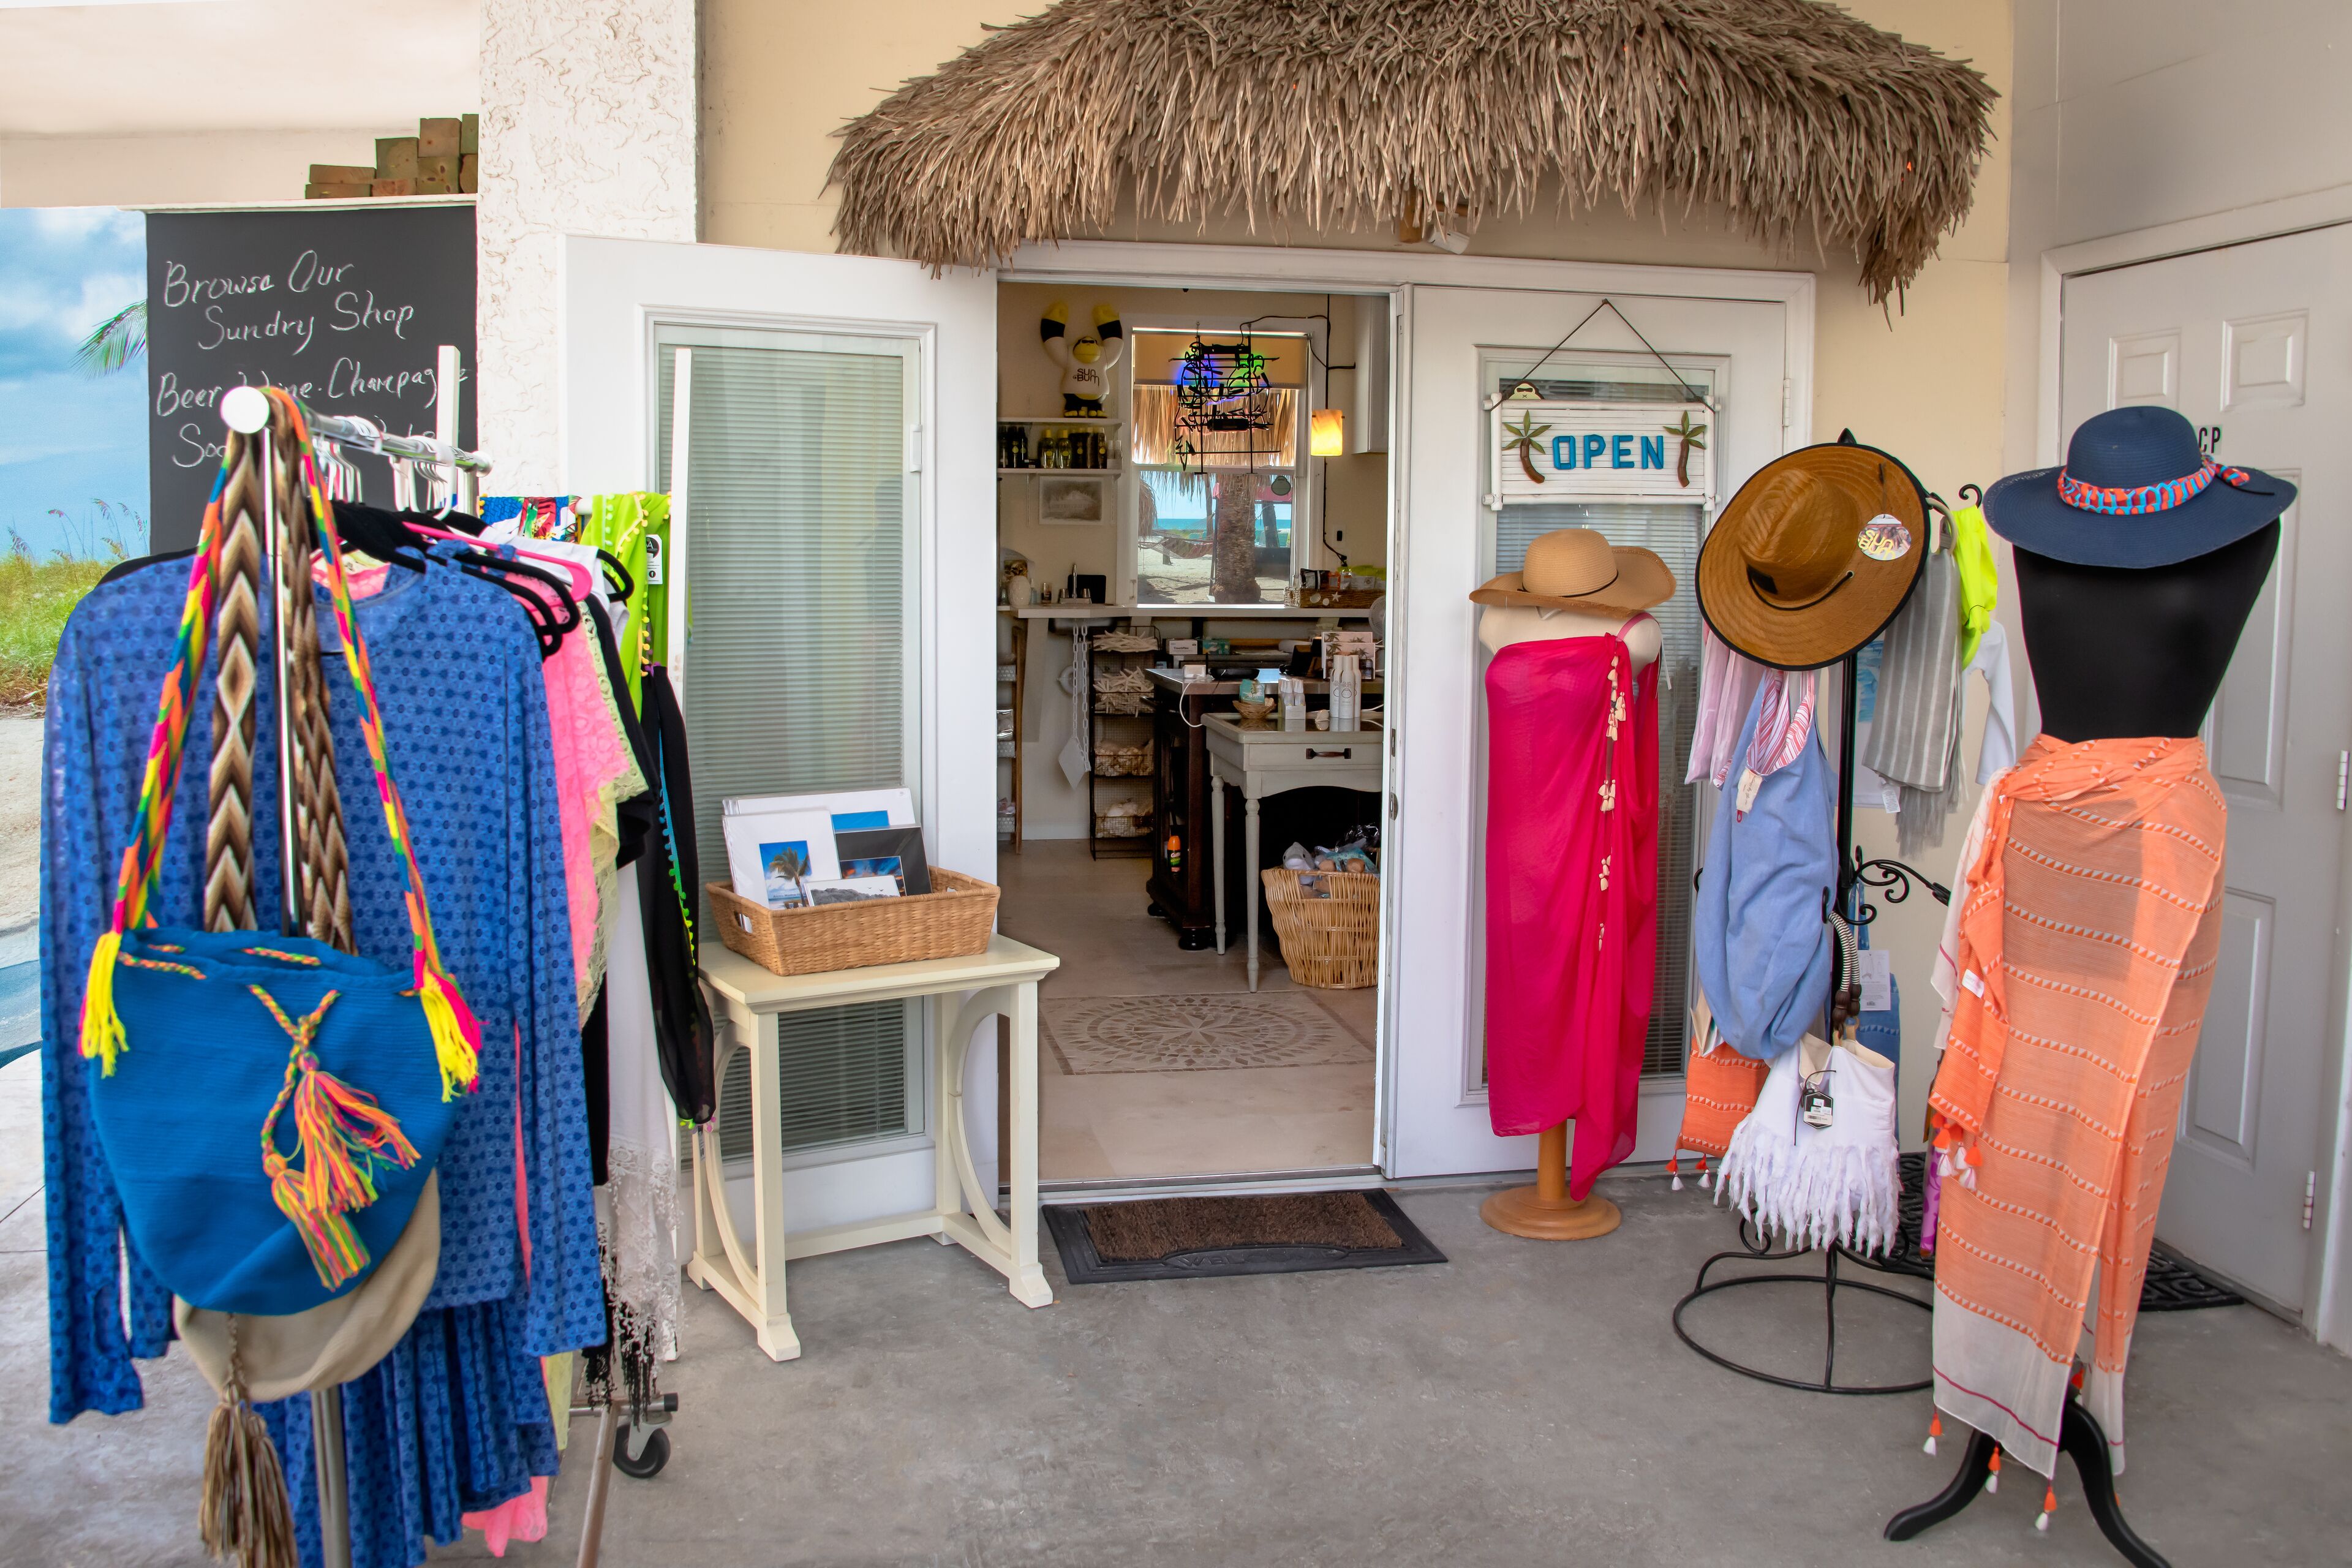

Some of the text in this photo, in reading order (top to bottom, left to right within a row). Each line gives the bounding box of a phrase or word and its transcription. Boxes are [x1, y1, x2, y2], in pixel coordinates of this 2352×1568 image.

[164, 249, 355, 307] Browse Our
[197, 290, 415, 356] Sundry Shop
[156, 371, 222, 417] Beer
[1553, 434, 1664, 470] OPEN
